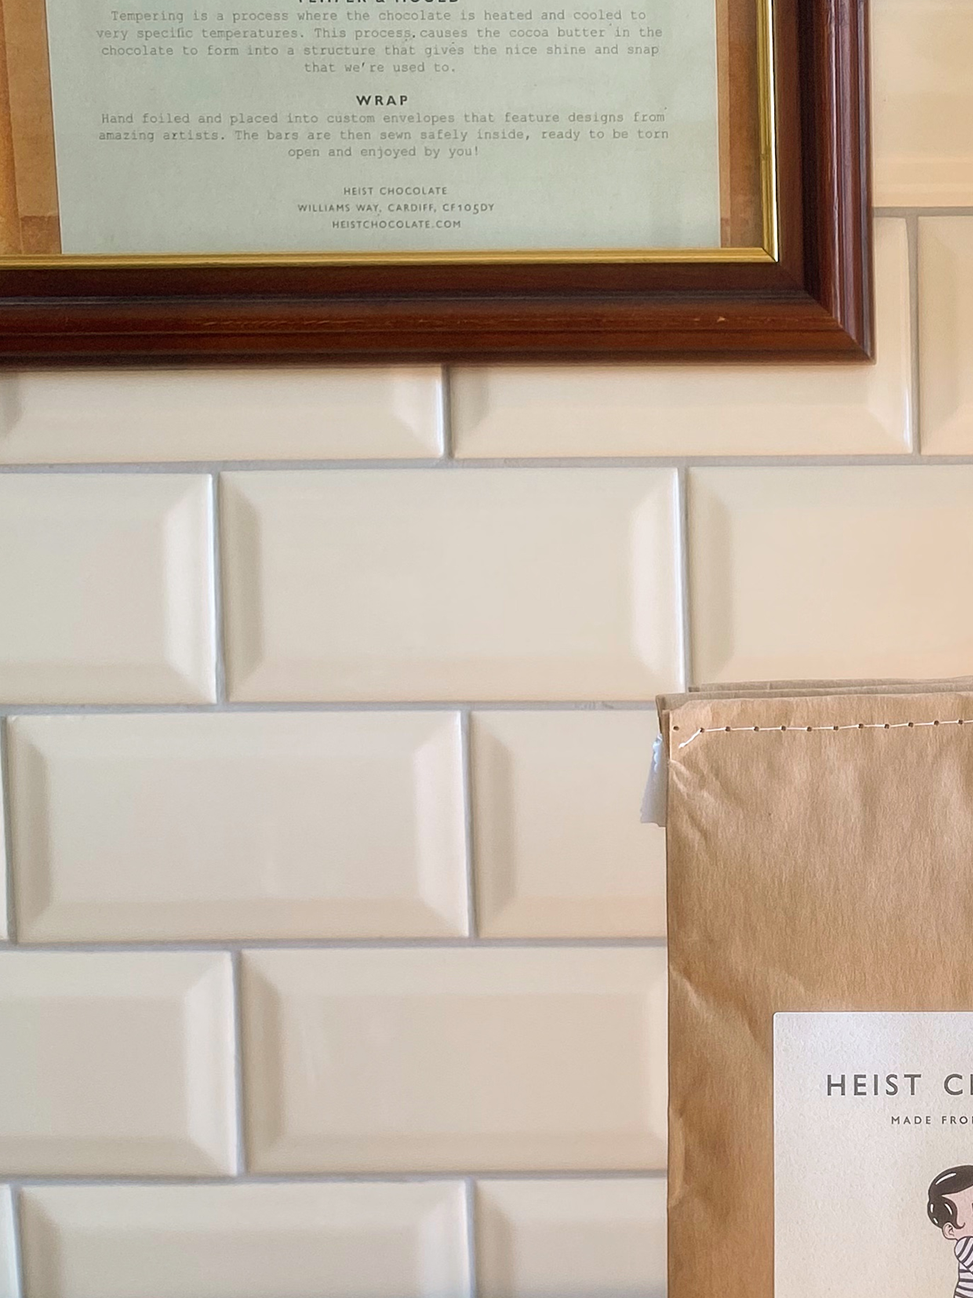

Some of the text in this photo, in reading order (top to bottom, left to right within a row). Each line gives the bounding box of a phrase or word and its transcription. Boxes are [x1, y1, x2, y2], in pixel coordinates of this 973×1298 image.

[111, 10, 645, 23] Tempering is a process where the chocolate is heated and cooled to
[96, 29, 128, 40] very
[137, 27, 193, 41] specific
[202, 28, 303, 41] temperatures.
[314, 27, 346, 38] This
[420, 30, 467, 38] causes
[477, 27, 500, 37] the
[509, 29, 548, 37] cocoa
[557, 27, 605, 37] butter
[614, 26, 630, 37] in
[639, 27, 662, 37] the
[102, 44, 659, 58] chocolate to form into a structure that gives the nice shine and snap
[305, 61, 455, 73] that we're used to.
[356, 95, 408, 106] WRAP
[102, 112, 664, 126] Hand foiled and placed into custom envelopes that feature designs from
[99, 129, 668, 142] amazing artists. The bars are then sewn safely inside, ready to be torn
[288, 146, 477, 159] open and enjoyed by you!
[344, 187, 447, 195] HEIST CHOCOLATE
[298, 203, 494, 214] WILLIAMS WAY, CARDIFF, CF105DY
[332, 220, 461, 229] HEISTCHOCOLATE.COM
[827, 1073, 922, 1097] HEIST
[891, 1115, 932, 1125] MADE
